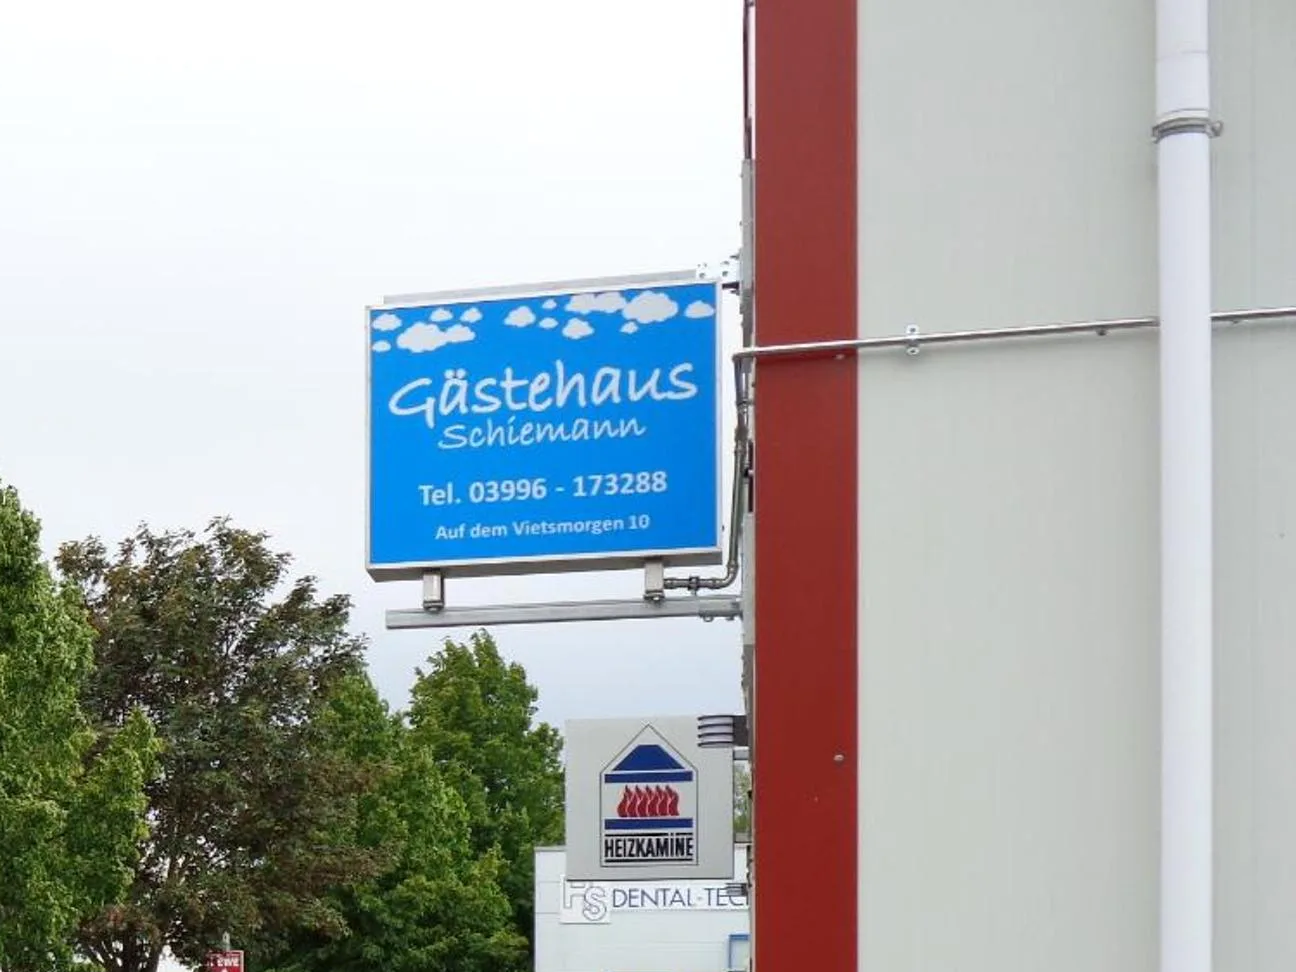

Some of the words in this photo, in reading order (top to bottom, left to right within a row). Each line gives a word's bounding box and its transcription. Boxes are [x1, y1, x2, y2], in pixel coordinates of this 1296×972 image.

[389, 360, 698, 427] Gästehaus
[438, 416, 646, 450] Schiemann
[419, 483, 461, 506] Tel.
[469, 477, 546, 503] 03996
[573, 470, 668, 497] 173288
[436, 523, 466, 540] Auf
[470, 522, 507, 537] dem
[513, 516, 625, 536] Vietsmorgen
[629, 514, 650, 530] 10
